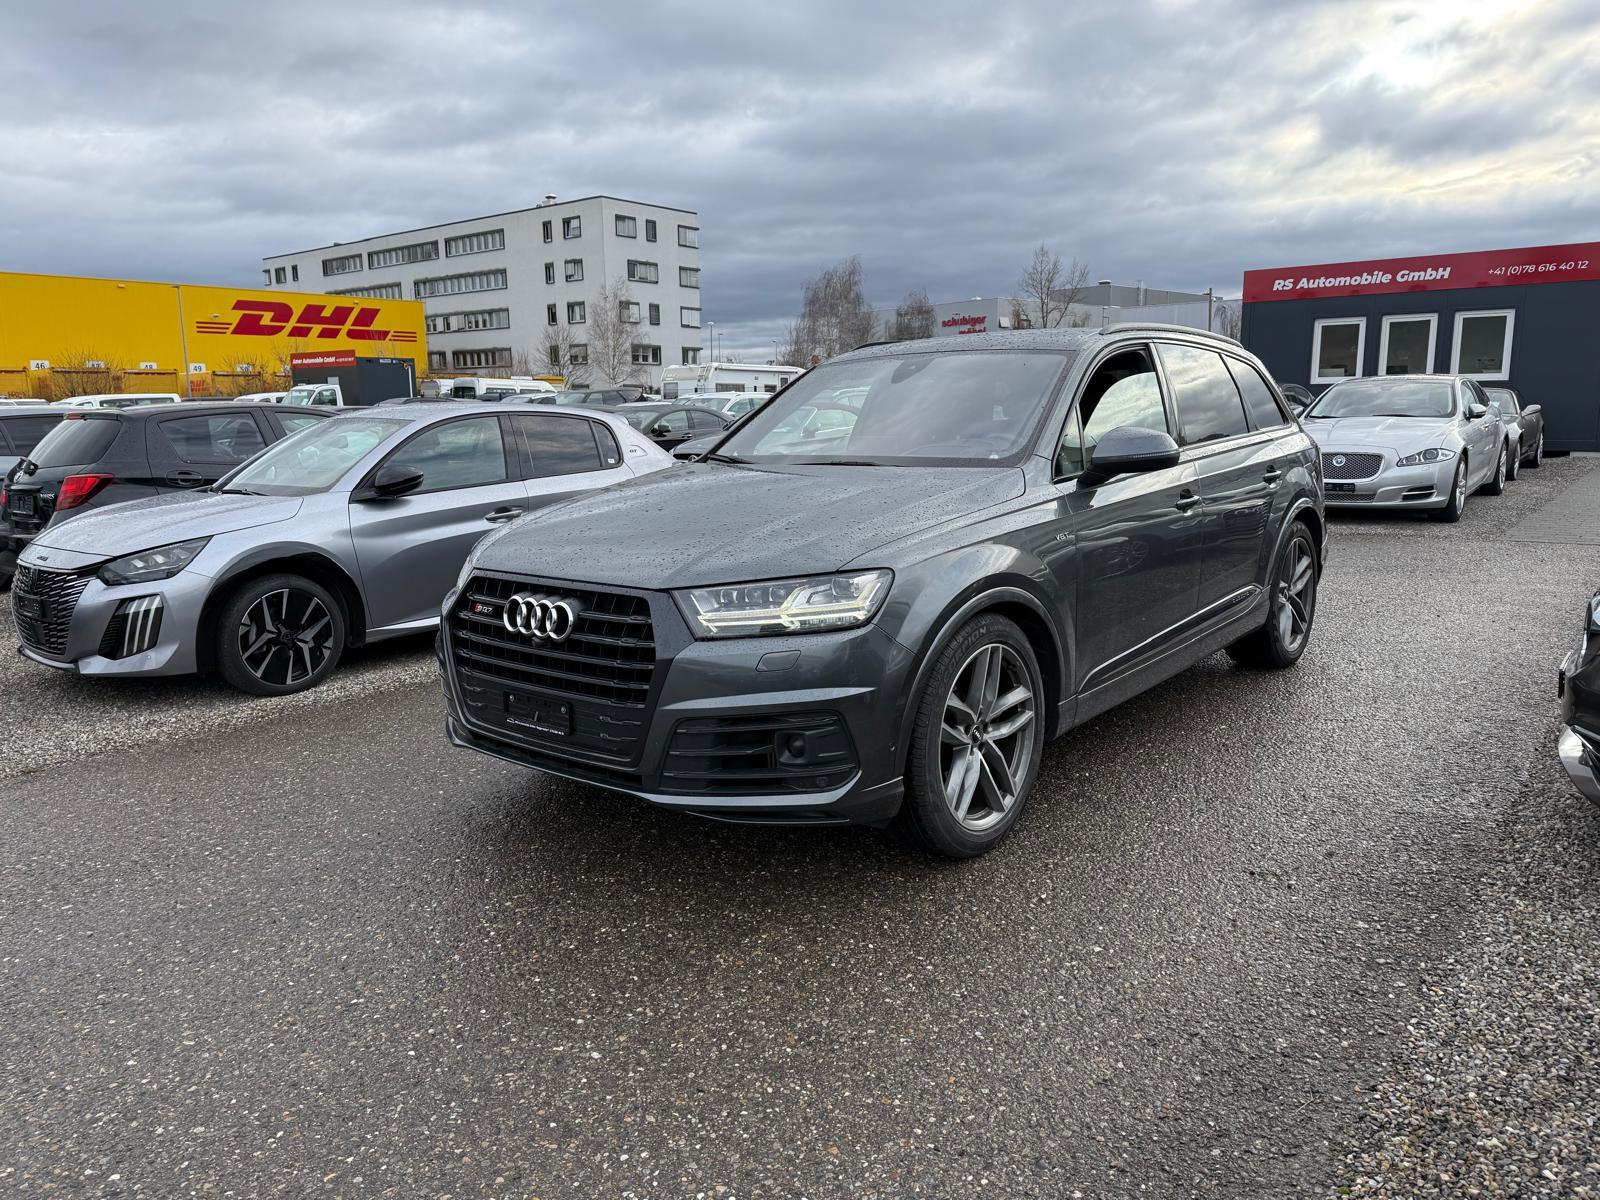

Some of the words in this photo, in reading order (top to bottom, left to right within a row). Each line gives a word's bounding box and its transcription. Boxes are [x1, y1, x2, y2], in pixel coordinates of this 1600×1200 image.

[1488, 266, 1505, 275] +41
[1507, 264, 1536, 276] (0)78
[1537, 262, 1557, 272] 616
[1558, 261, 1575, 270] 40
[1577, 260, 1589, 269] 12
[1272, 278, 1294, 291] RS
[1296, 270, 1392, 289] Automobile
[1396, 267, 1451, 282] GmbH
[230, 299, 391, 341] DHL
[941, 315, 987, 327] schubiger
[303, 356, 324, 364] Automobile
[193, 364, 203, 372] 49
